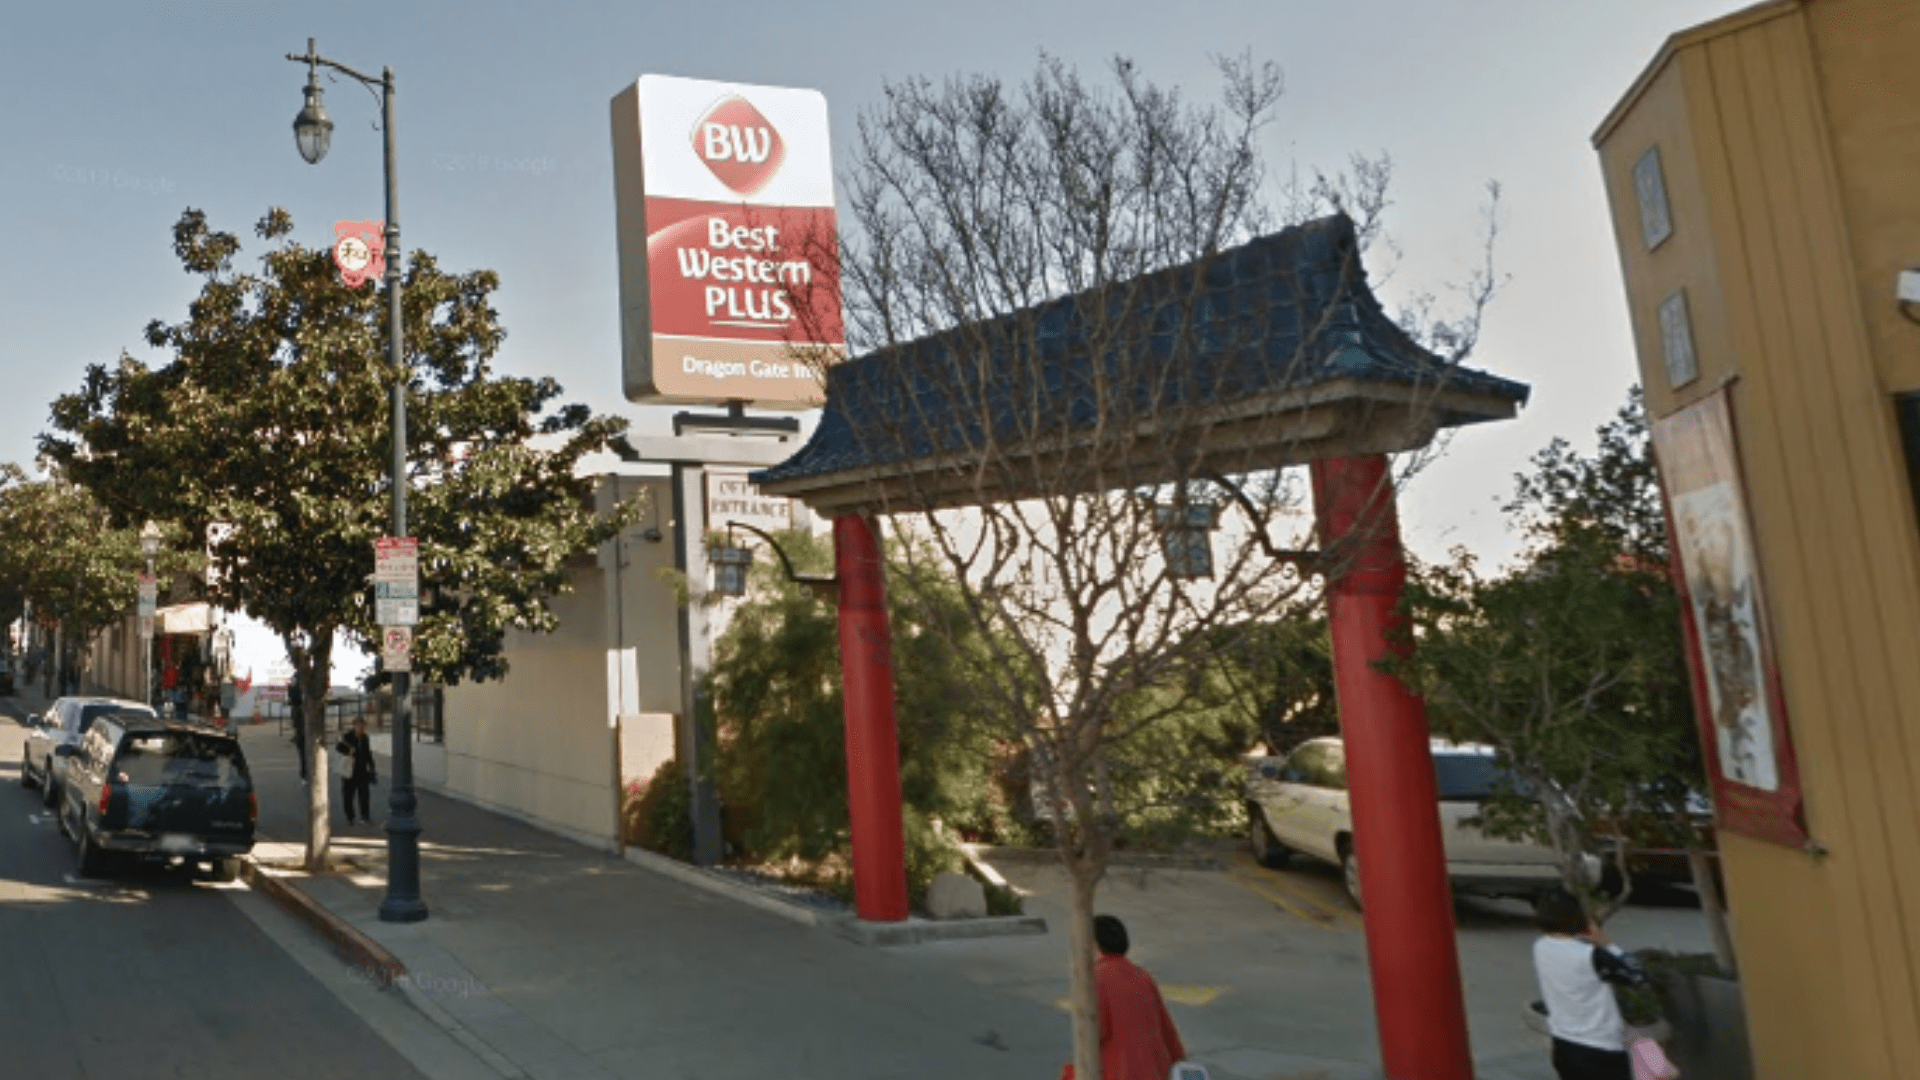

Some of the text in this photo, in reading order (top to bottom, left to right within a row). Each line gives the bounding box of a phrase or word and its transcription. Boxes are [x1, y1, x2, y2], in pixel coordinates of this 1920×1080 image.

[704, 122, 771, 164] BW
[708, 217, 781, 252] Best
[677, 247, 811, 284] Western
[682, 355, 747, 379] Dragon
[749, 360, 790, 379] Gate
[711, 500, 788, 518] ENTRANCE
